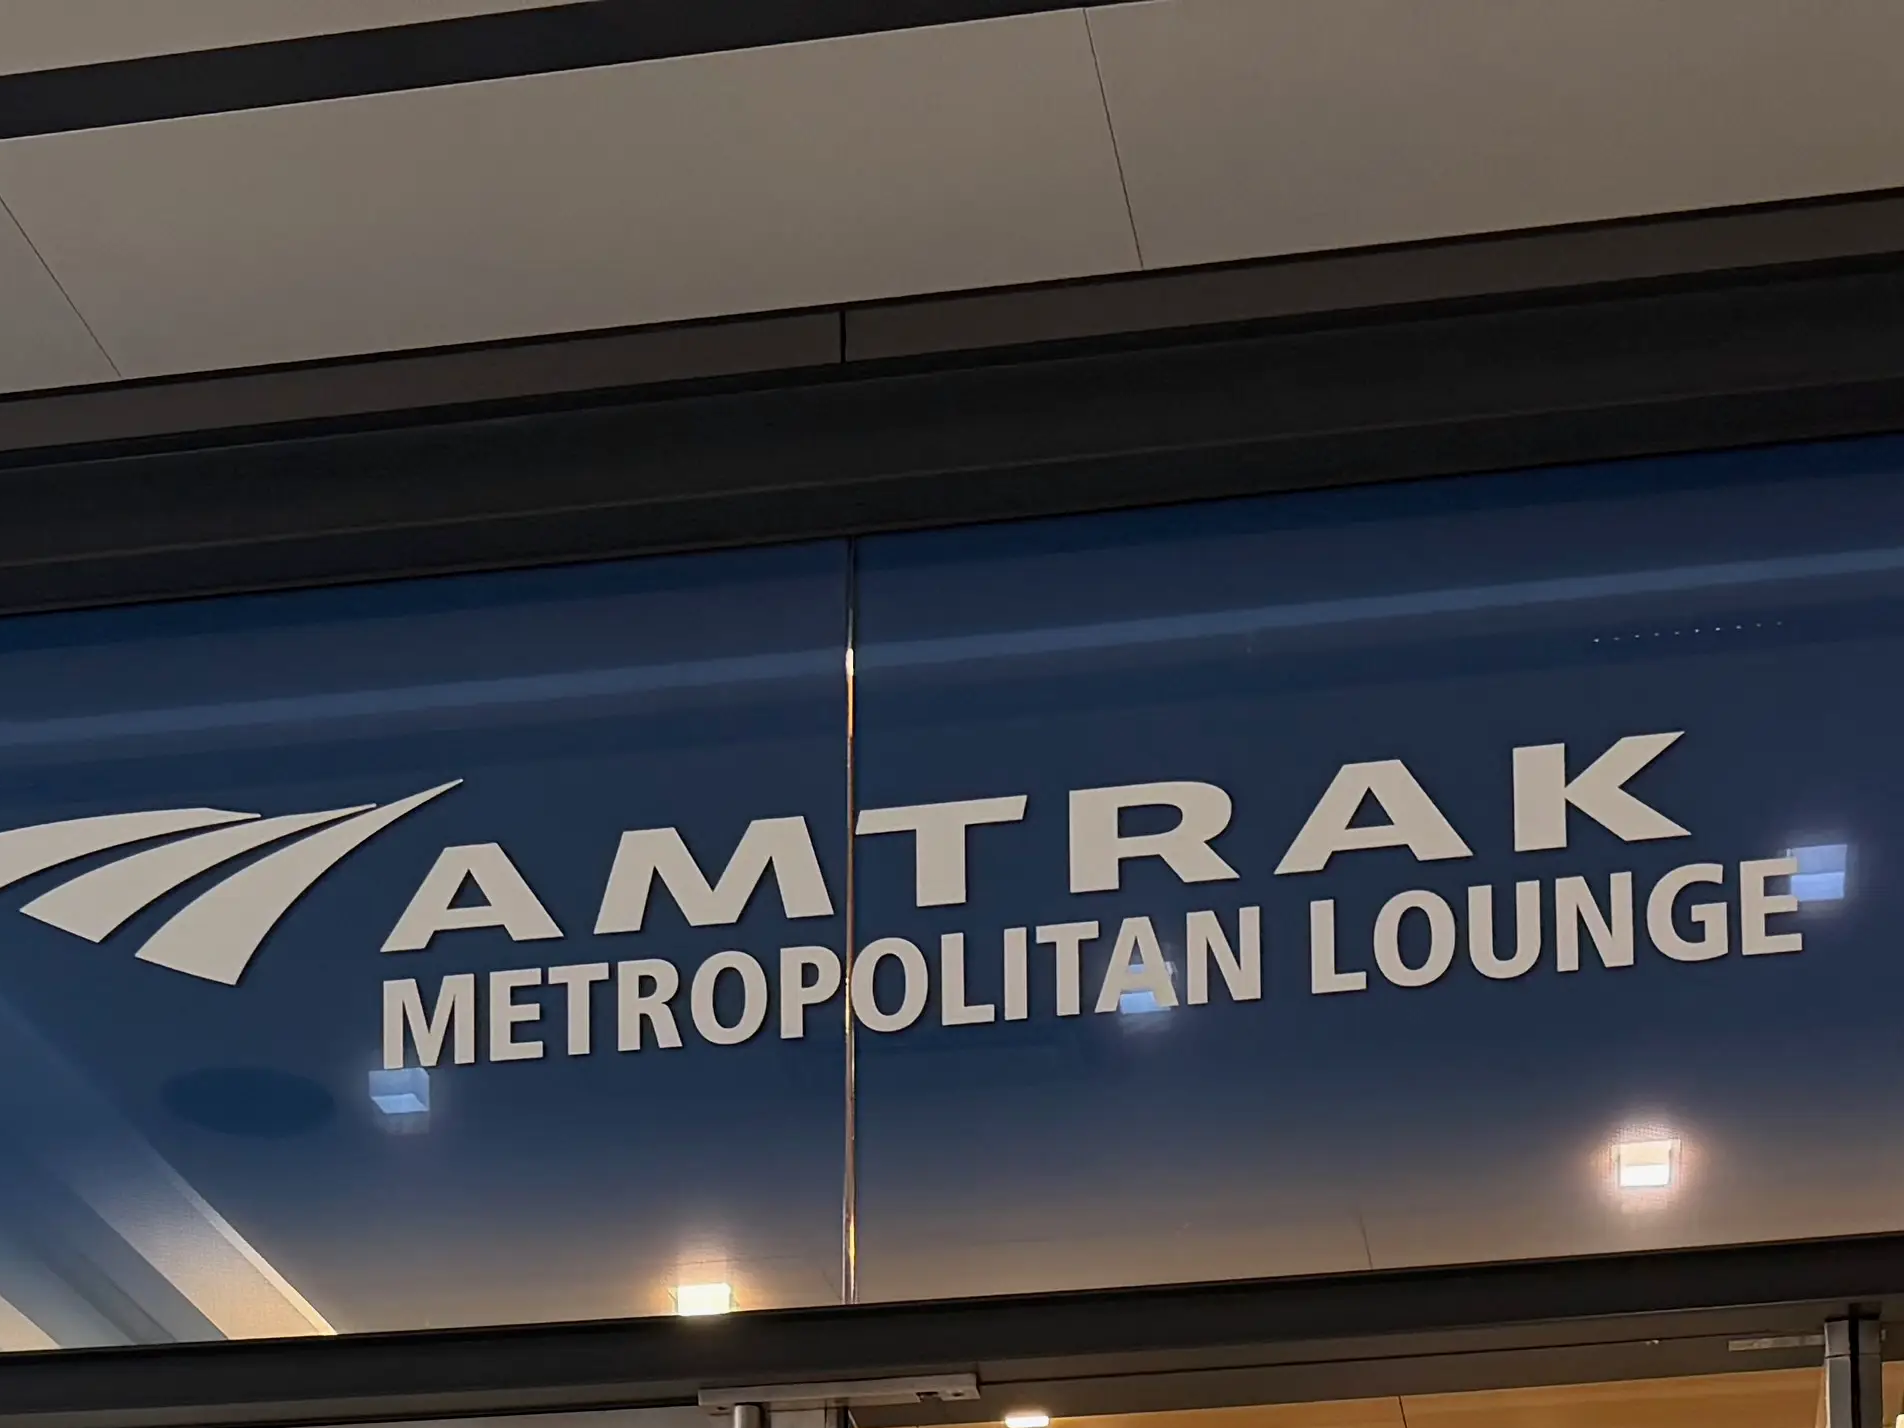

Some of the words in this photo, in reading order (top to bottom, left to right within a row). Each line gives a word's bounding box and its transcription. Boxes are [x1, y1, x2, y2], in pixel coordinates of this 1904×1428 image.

[380, 731, 1692, 953] AMTRAK
[383, 906, 1262, 1069] METROPOLITAN
[1310, 858, 1803, 994] LOUNGE
